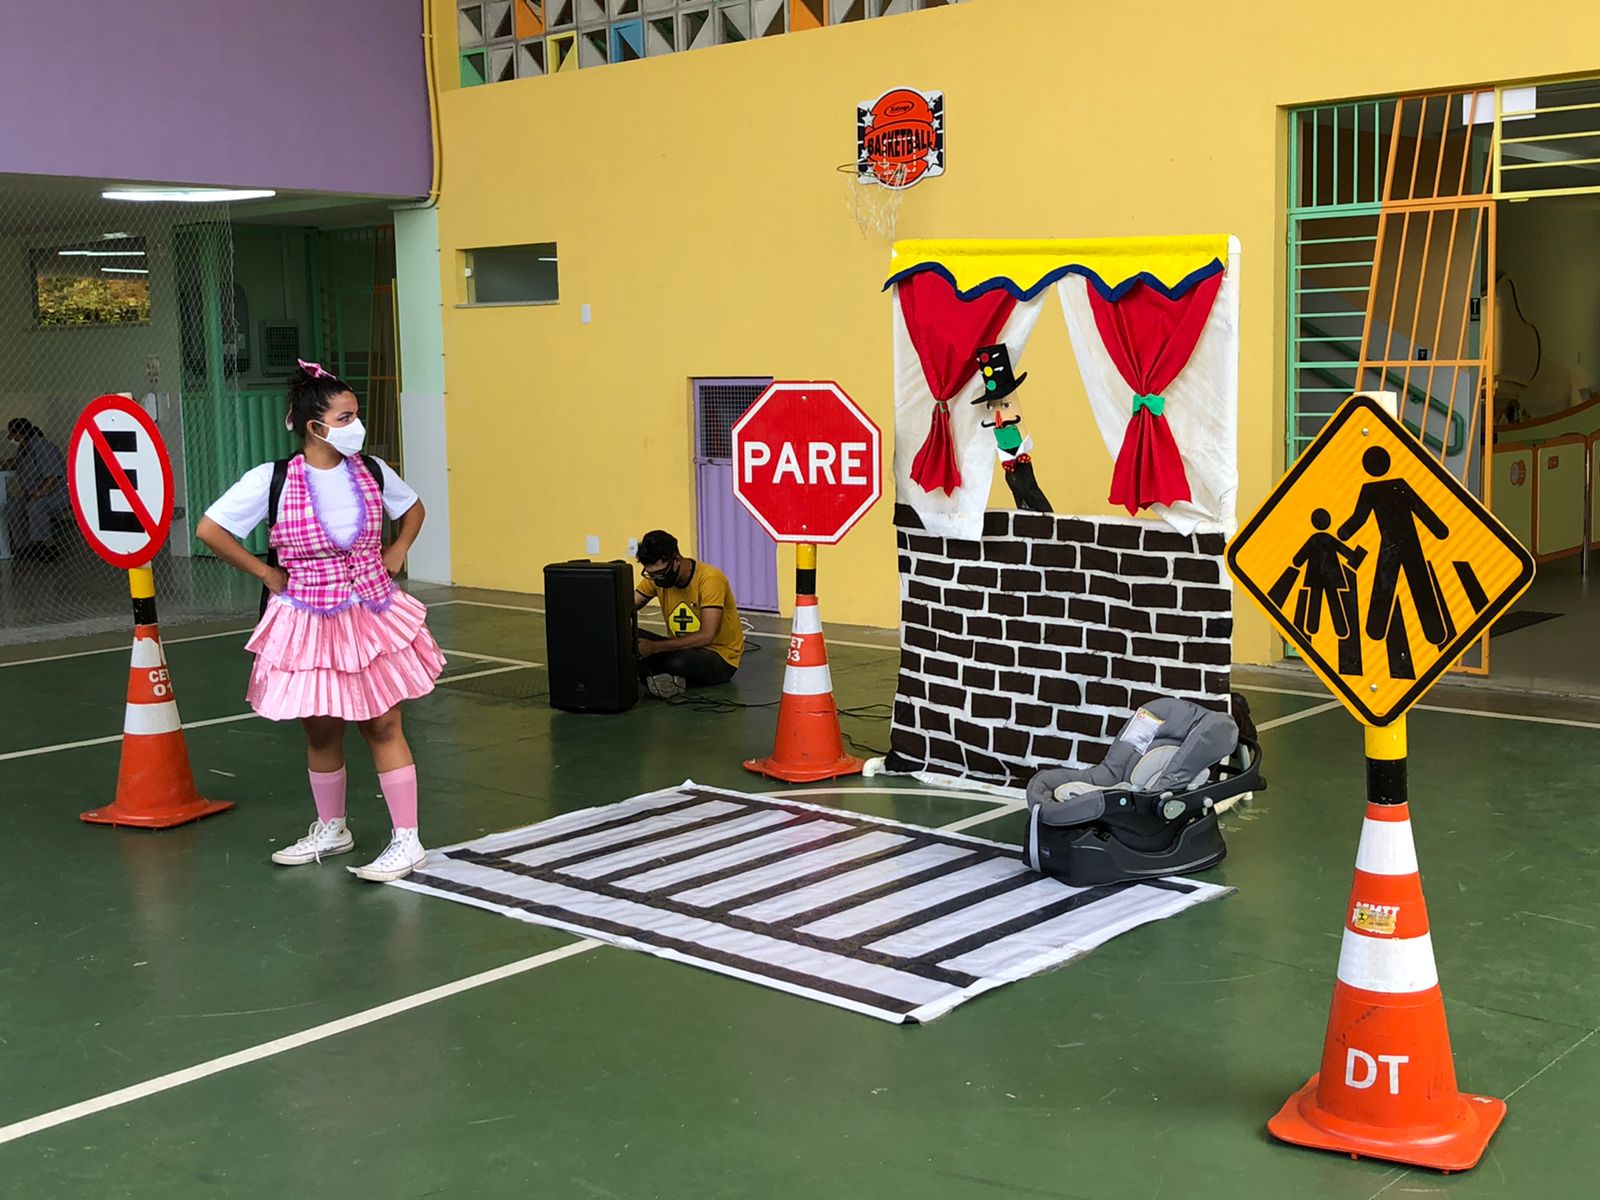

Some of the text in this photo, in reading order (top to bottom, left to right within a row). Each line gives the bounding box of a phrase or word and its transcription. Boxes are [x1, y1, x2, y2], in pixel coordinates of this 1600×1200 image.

[867, 128, 933, 158] BASKETBALL
[93, 431, 146, 533] E
[743, 441, 867, 485] PARE
[1344, 1047, 1410, 1095] DT
